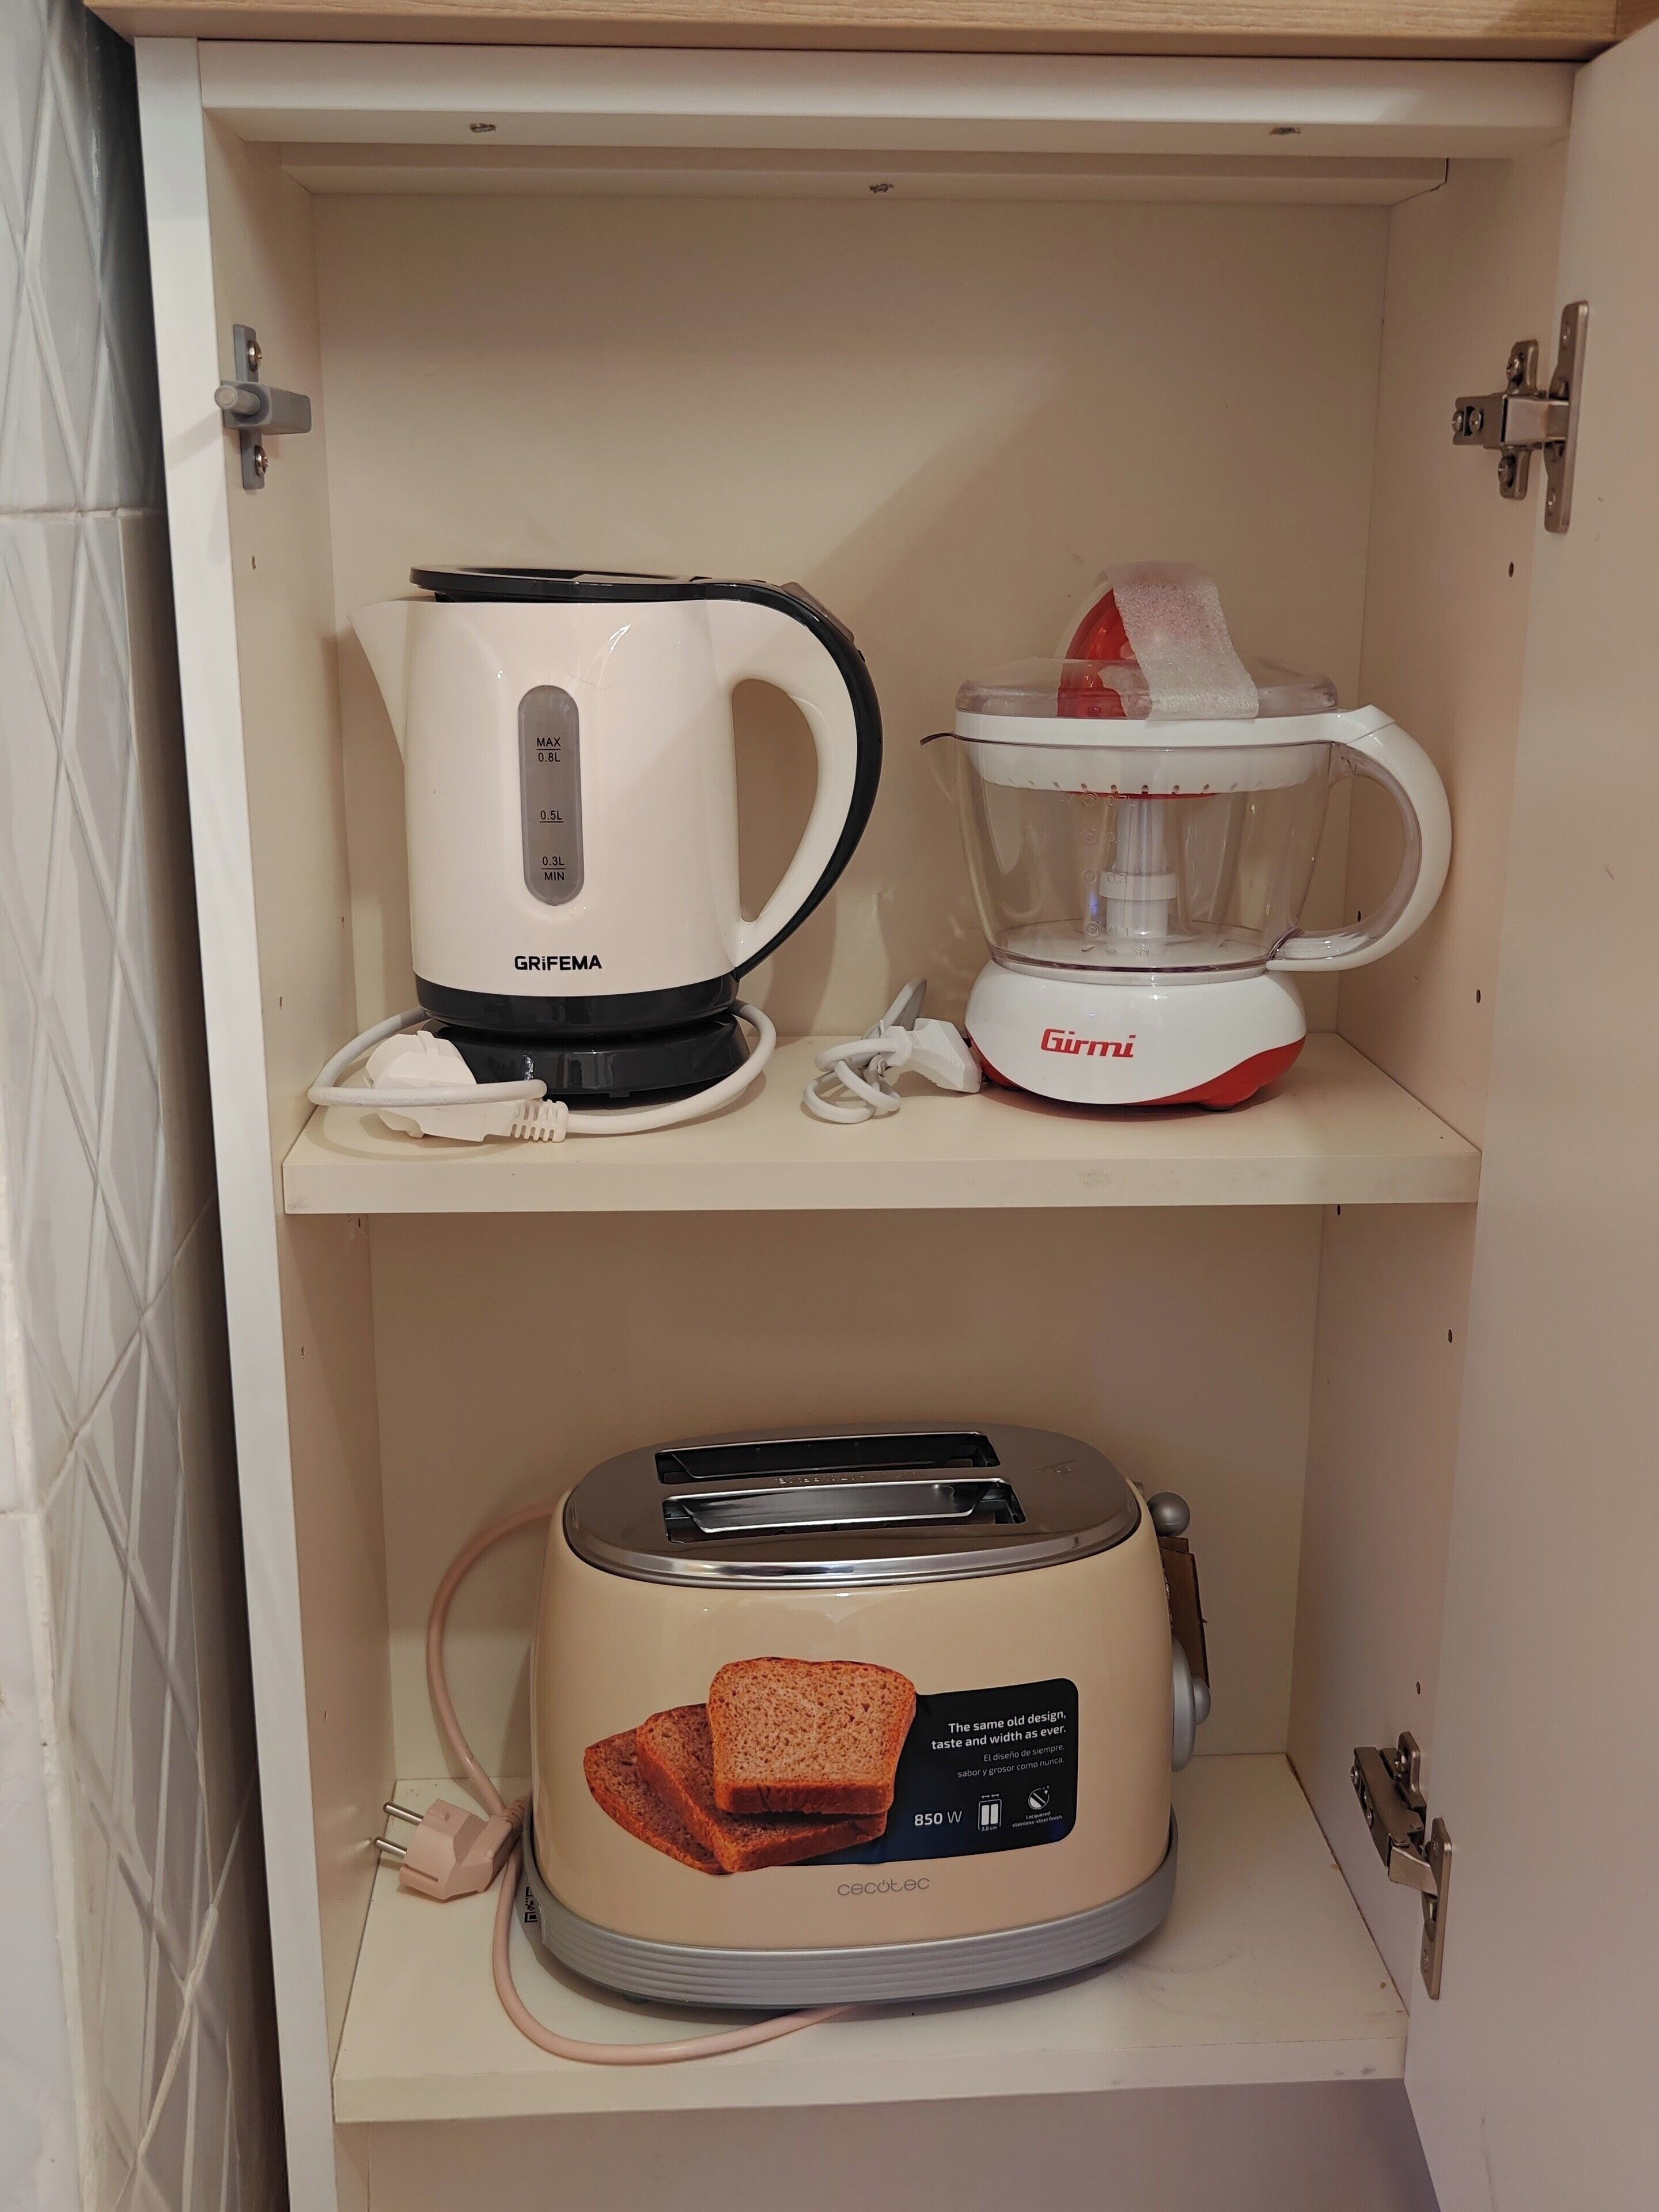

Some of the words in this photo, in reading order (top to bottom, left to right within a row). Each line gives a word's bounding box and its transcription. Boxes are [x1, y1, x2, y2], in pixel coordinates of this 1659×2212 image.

[537, 737, 561, 747] MAX
[538, 752, 560, 762] 0.8L
[540, 810, 562, 820] 0.5L
[542, 856, 565, 866] 0.3L
[544, 872, 565, 881] MIN
[1041, 1028, 1136, 1058] Girmi
[948, 1723, 970, 1733] The
[974, 1719, 1004, 1731] same
[1007, 1715, 1024, 1727] old
[1028, 1710, 1066, 1724] design,
[931, 1739, 962, 1749] taste
[965, 1736, 987, 1747] and
[990, 1732, 1022, 1744] width
[1025, 1730, 1037, 1738] as
[1041, 1725, 1066, 1736] ever.
[993, 1750, 1019, 1760] diseño
[1032, 1744, 1065, 1755] siempre,
[957, 1769, 981, 1778] sabor
[989, 1766, 1014, 1776] grosor
[1017, 1762, 1038, 1770] como
[1040, 1757, 1065, 1767] nunca.
[914, 1812, 943, 1826] 850
[947, 1810, 962, 1823] W
[837, 1877, 930, 1896] cecotec
